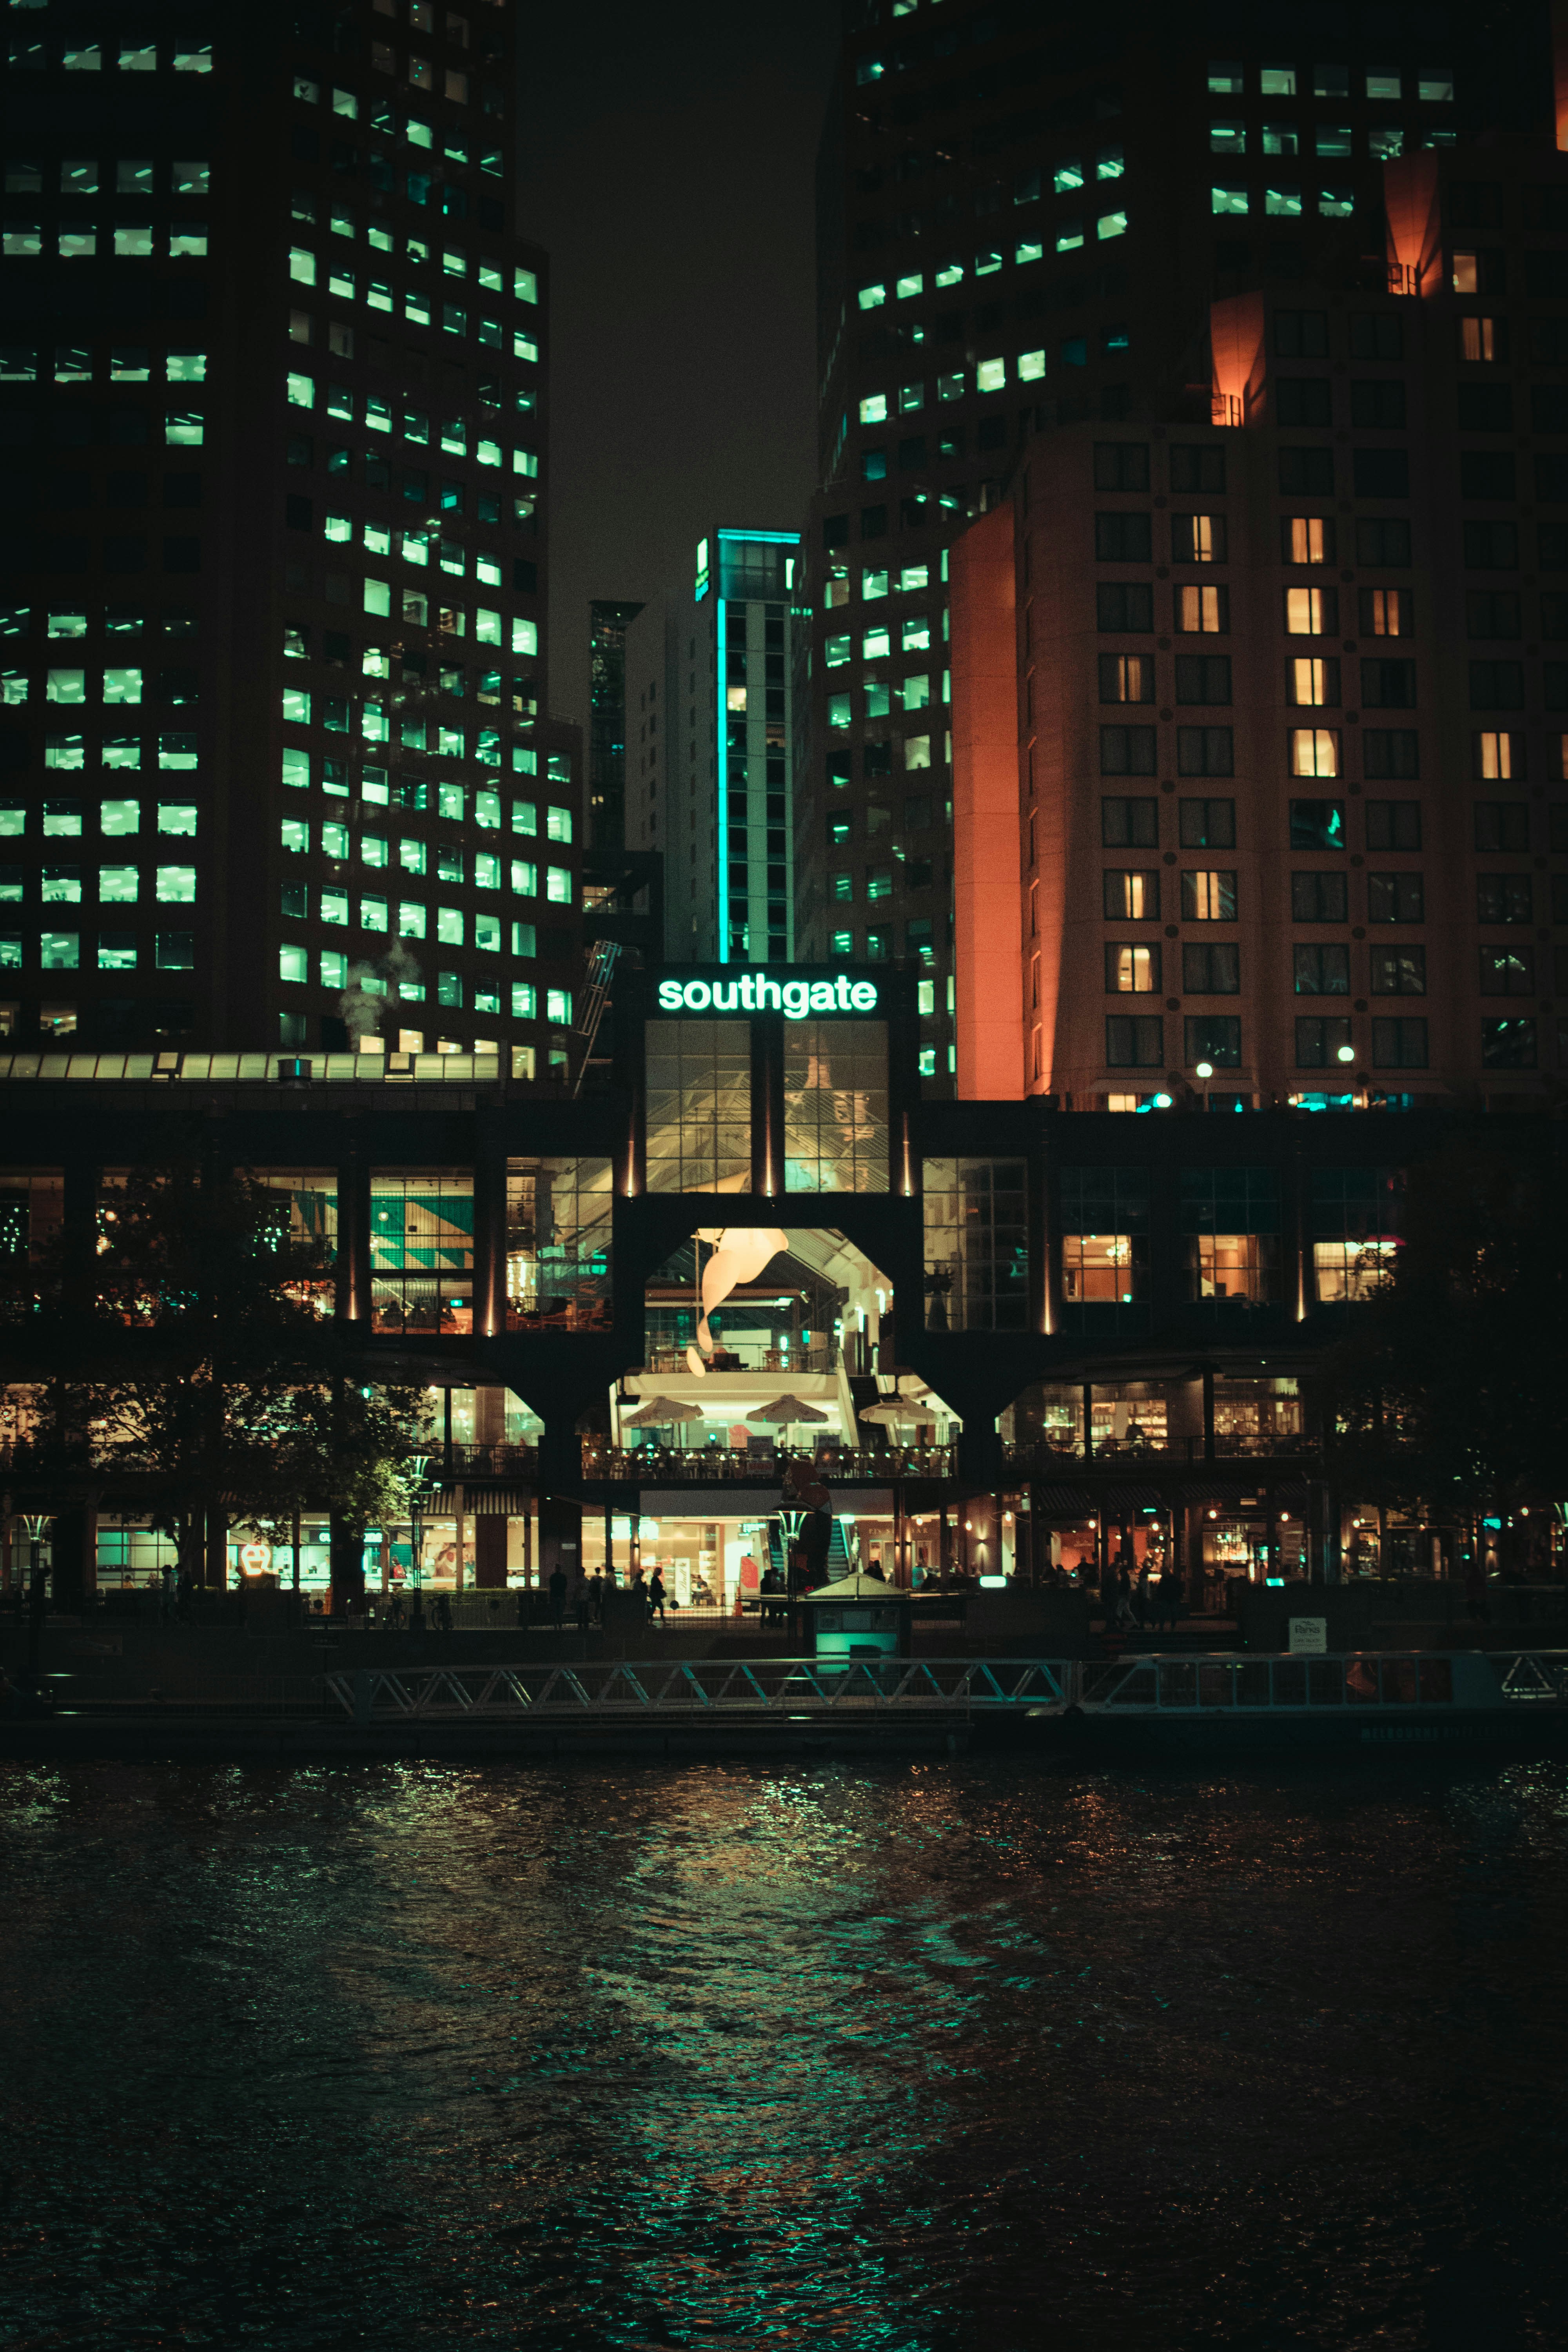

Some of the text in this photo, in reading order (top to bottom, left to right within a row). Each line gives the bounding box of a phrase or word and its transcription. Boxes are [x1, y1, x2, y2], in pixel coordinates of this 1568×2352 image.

[658, 973, 878, 1019] southgate
[1361, 1725, 1522, 1739] MELBOURNE RIVER CRUISES
